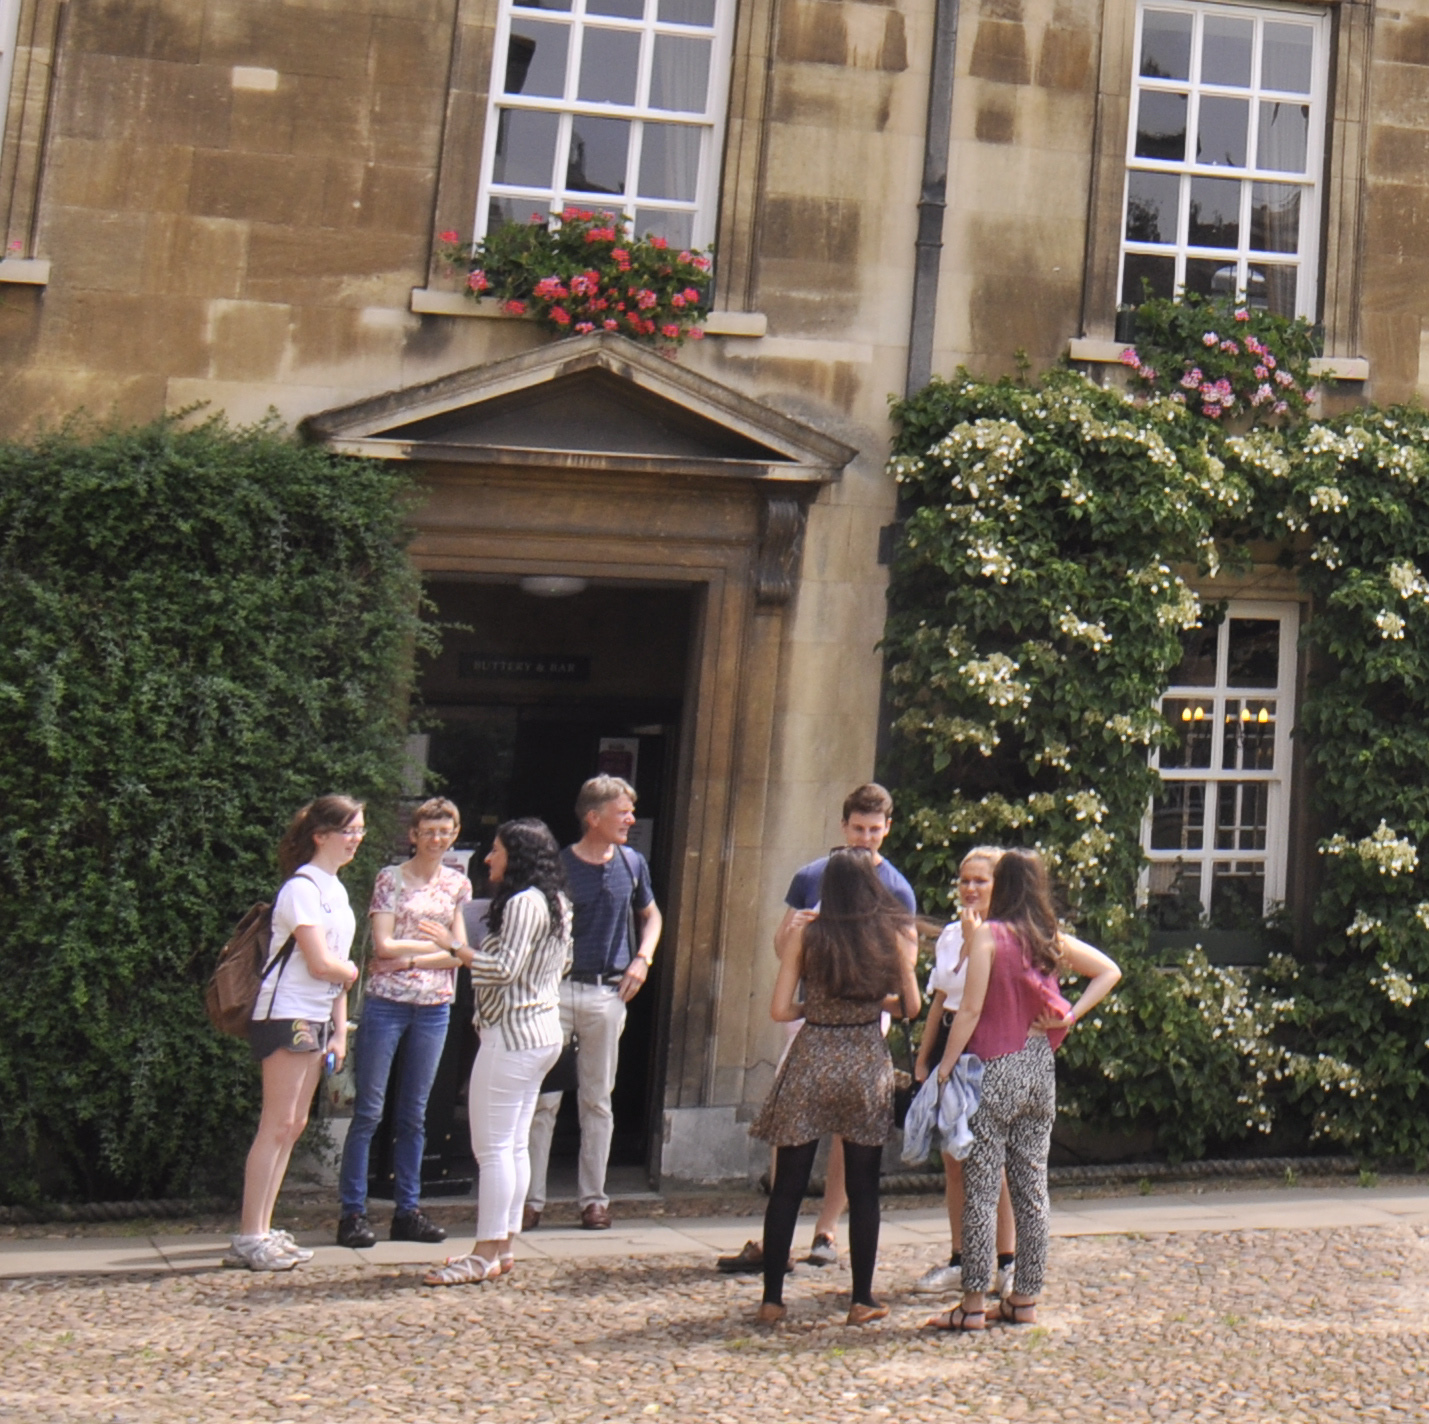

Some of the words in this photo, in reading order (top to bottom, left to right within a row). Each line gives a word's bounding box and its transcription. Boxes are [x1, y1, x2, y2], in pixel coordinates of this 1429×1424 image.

[473, 660, 531, 671] BUTTERY
[536, 662, 545, 672] &
[549, 663, 576, 672] BAR
